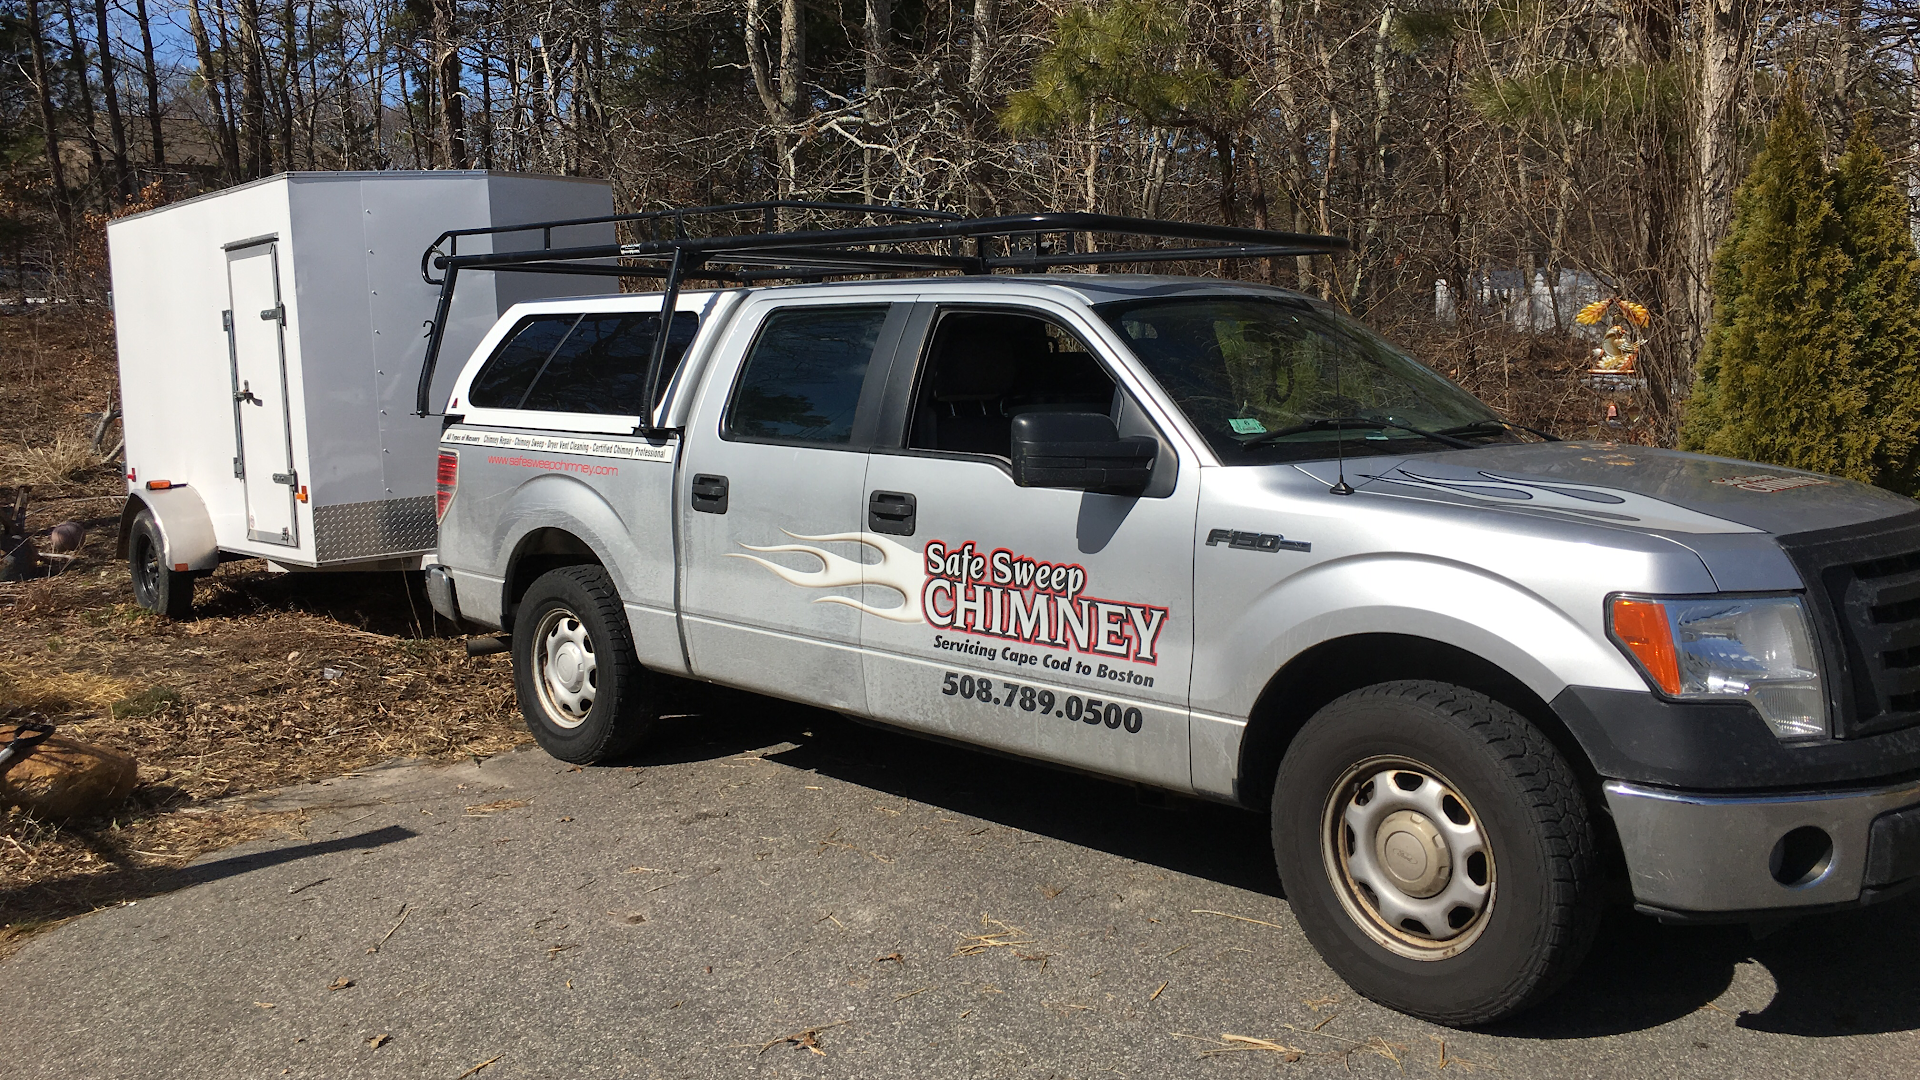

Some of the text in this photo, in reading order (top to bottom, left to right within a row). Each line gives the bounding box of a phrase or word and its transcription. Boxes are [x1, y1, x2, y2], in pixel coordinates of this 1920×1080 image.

[452, 433, 461, 441] Types
[466, 434, 480, 443] Masonry
[483, 435, 499, 444] Chimney
[500, 436, 512, 446] Repair
[514, 437, 531, 448] Chimney
[531, 438, 545, 449] Sweep
[547, 440, 559, 451] Dryer
[559, 440, 570, 450] Vent
[569, 441, 589, 453] Cleaning
[592, 443, 613, 454] Certified
[613, 444, 634, 457] Chimney
[634, 446, 666, 459] Professional
[488, 455, 619, 477] www.safesweepchimney.com
[926, 541, 1086, 600] Safe Sweep
[922, 577, 1168, 665] CHIMNEY
[933, 635, 1155, 688] Servicing Cape Cod to Boston
[942, 671, 1143, 733] 508.789.0500
